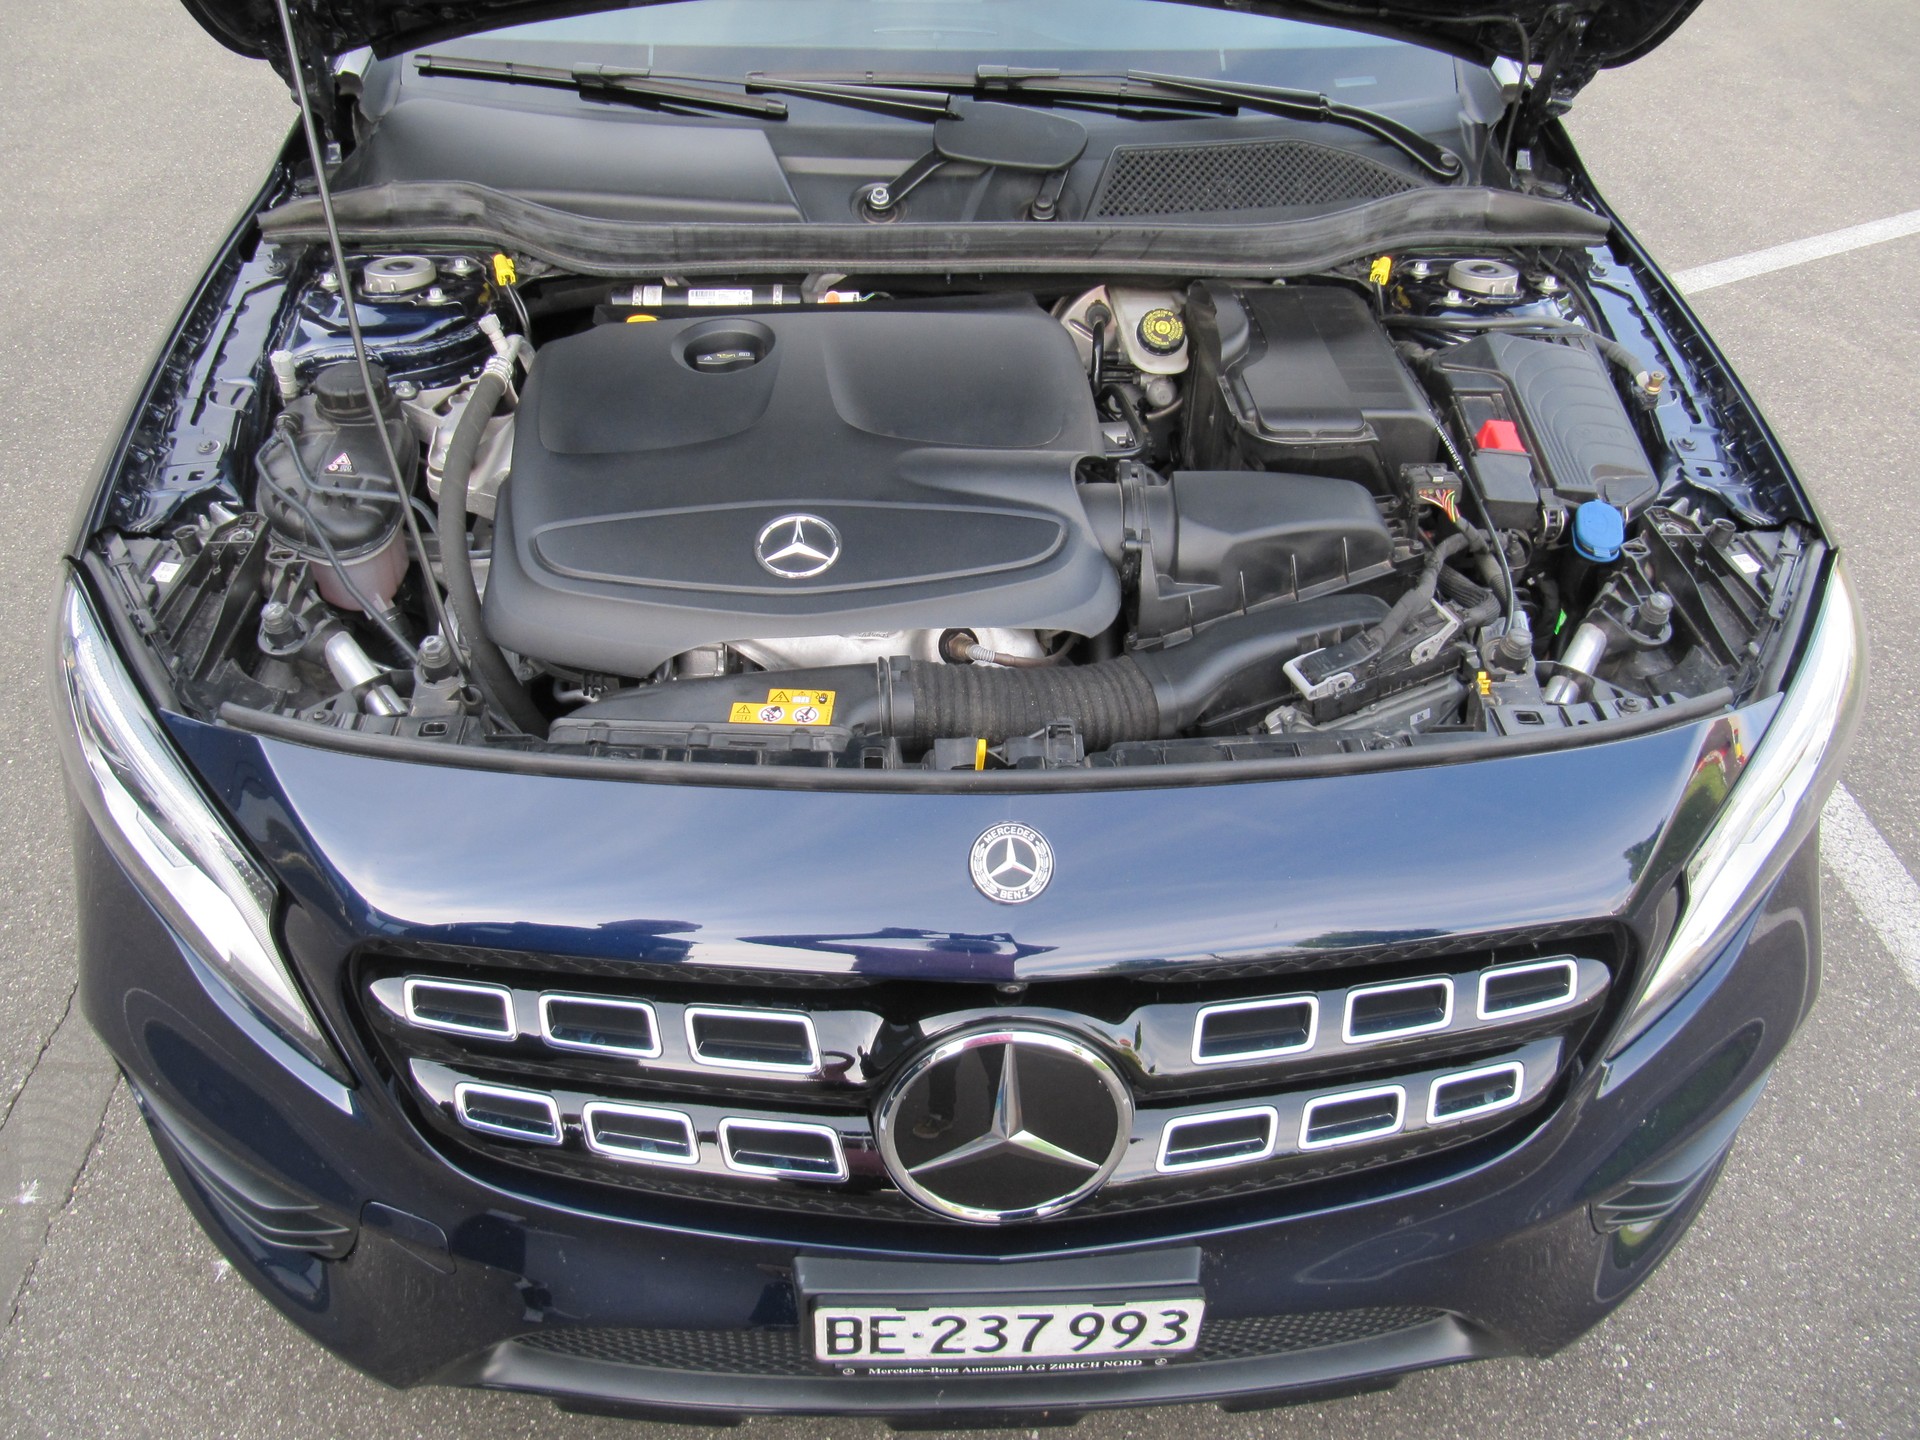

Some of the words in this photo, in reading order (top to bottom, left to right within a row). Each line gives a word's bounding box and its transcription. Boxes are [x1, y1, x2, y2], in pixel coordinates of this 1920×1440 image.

[983, 826, 1036, 844] MERCEDES
[999, 888, 1029, 900] BENZ
[868, 1367, 959, 1375] Mercedes-Benz
[962, 1364, 1023, 1374] Automobil
[1026, 1363, 1046, 1371] AG
[1103, 1359, 1142, 1368] NORD
